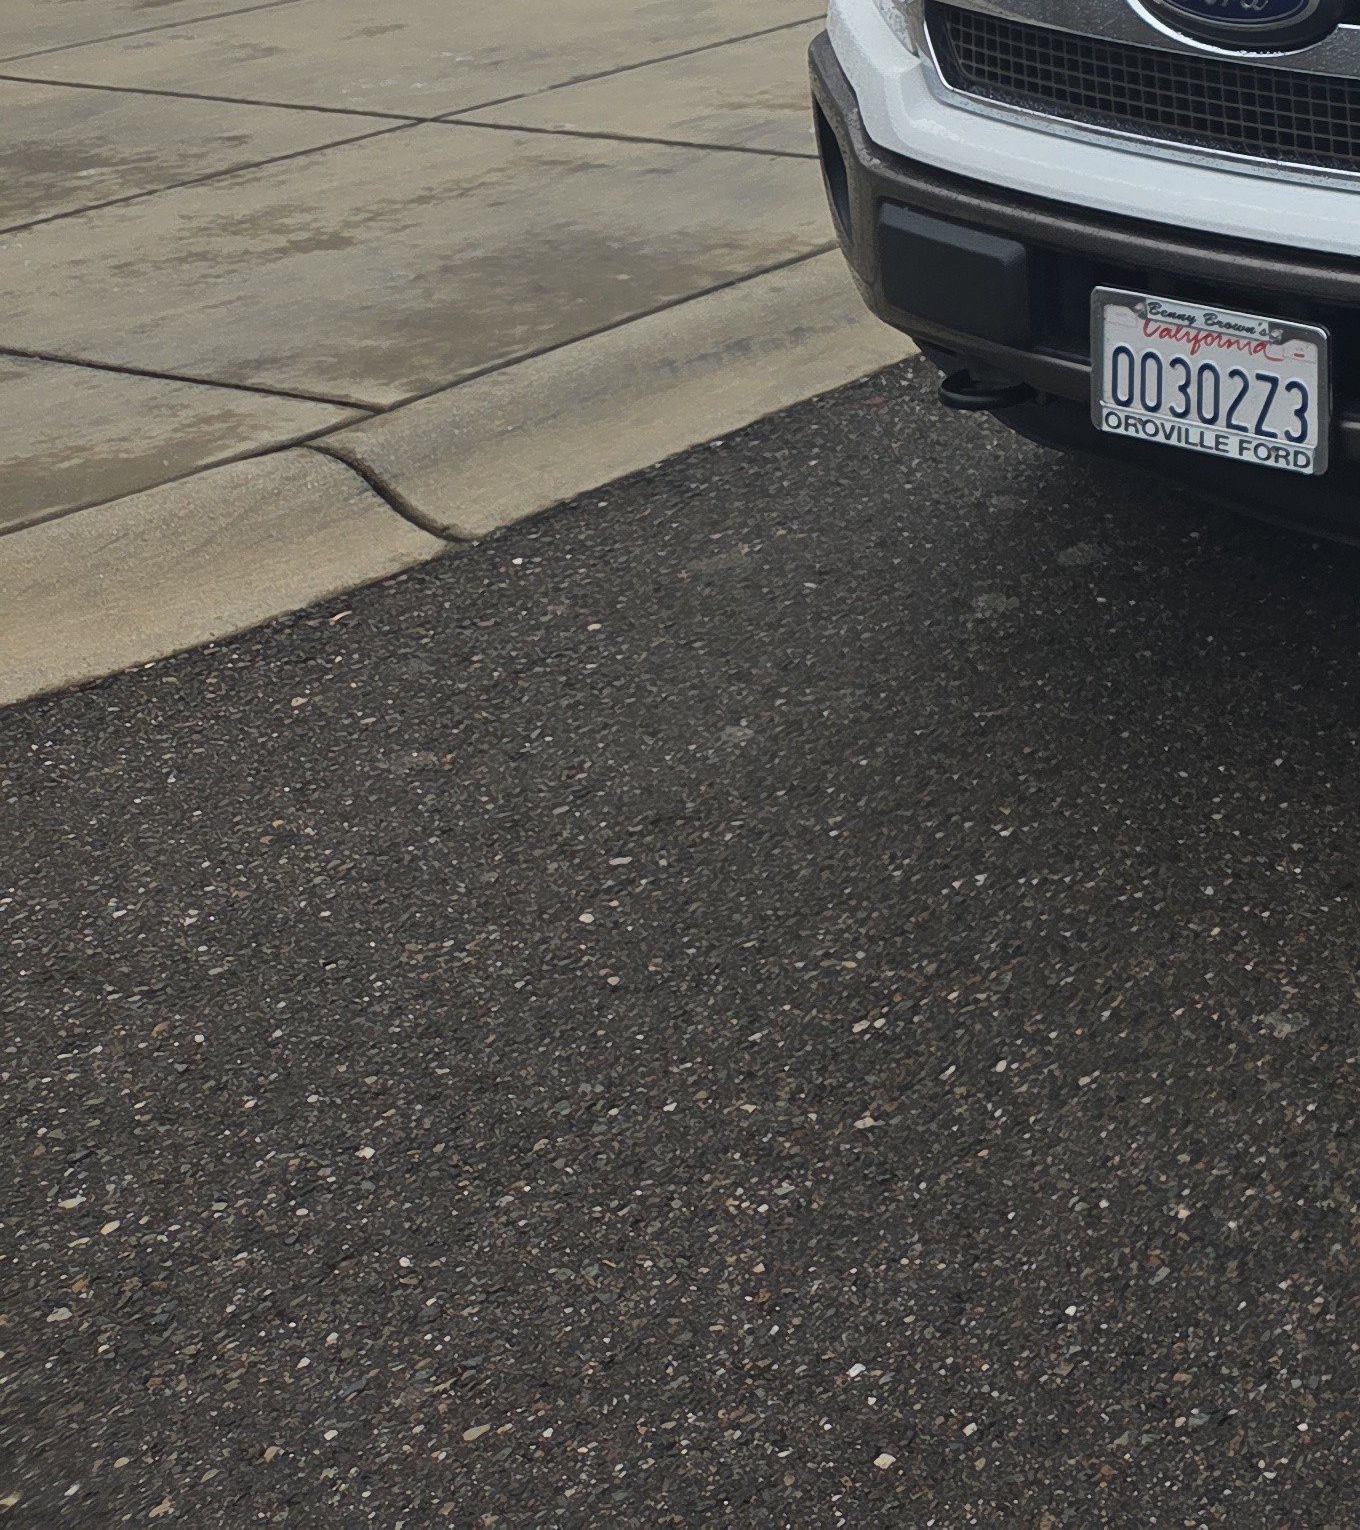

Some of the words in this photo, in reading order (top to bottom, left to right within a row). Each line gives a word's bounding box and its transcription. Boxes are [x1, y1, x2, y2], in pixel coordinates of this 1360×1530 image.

[1142, 319, 1284, 363] California
[1147, 301, 1197, 327] Benny
[1203, 312, 1270, 338] Brown's
[1111, 345, 1309, 444] 00302Z3
[1104, 410, 1229, 454] OROVILLE
[1238, 439, 1311, 470] FORD
